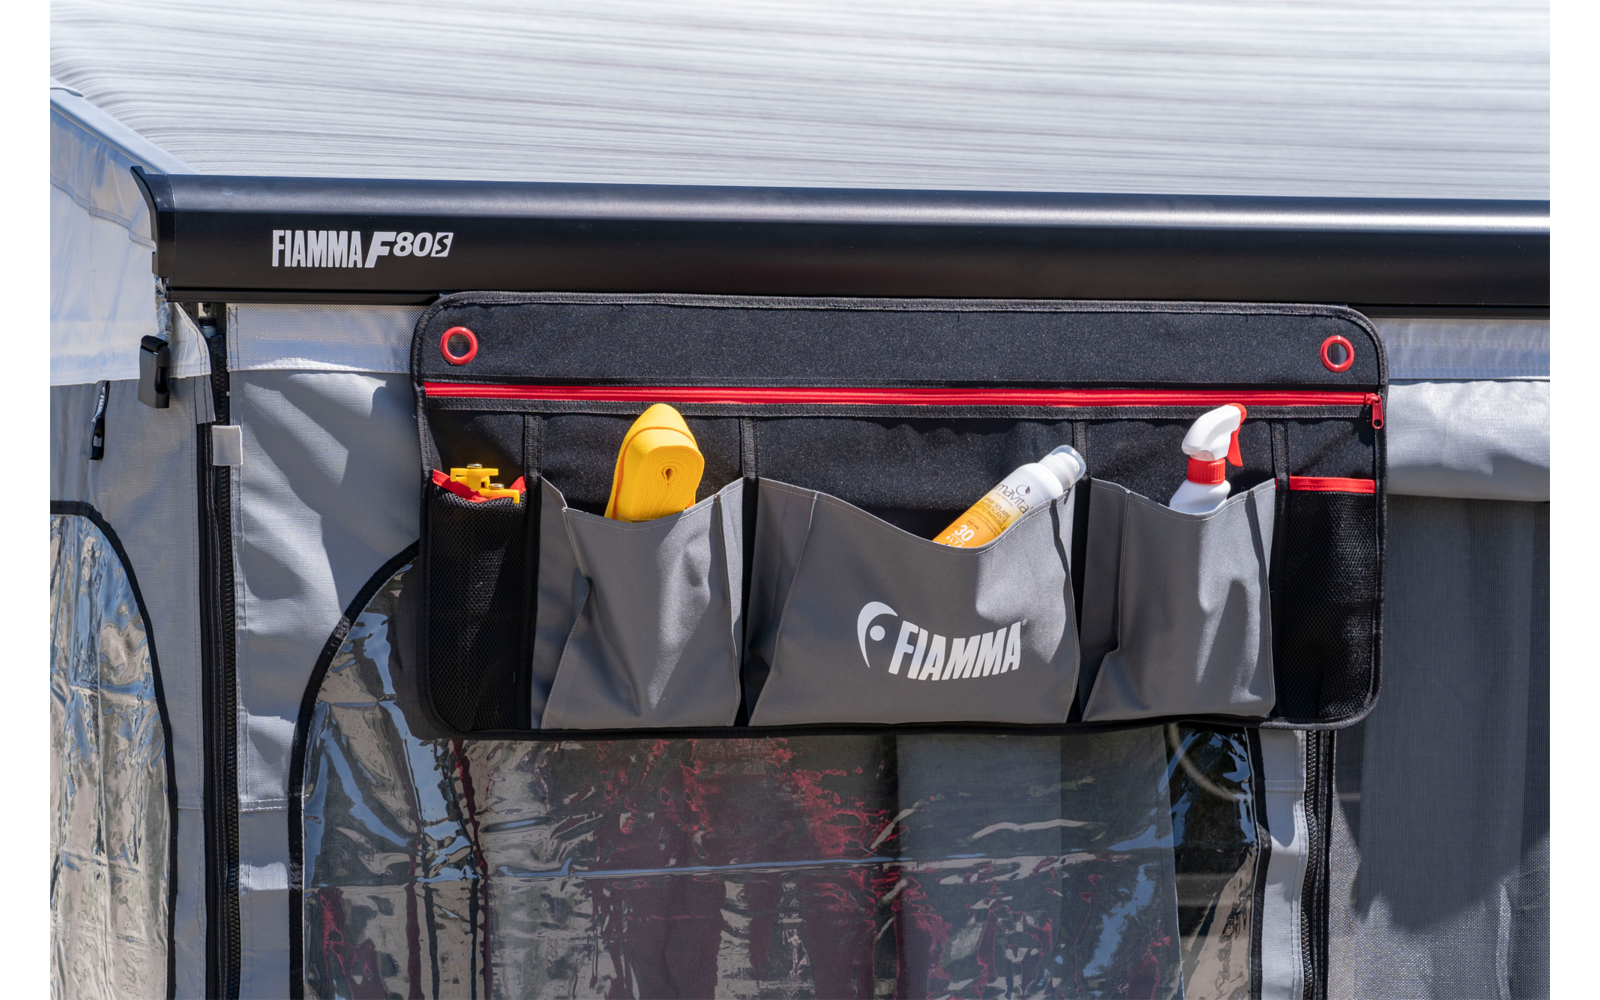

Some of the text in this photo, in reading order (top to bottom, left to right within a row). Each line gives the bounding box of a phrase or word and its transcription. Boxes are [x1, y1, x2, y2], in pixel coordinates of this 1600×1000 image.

[272, 230, 454, 268] FIAMMA F80S
[993, 502, 1011, 520] SOLARE
[994, 483, 1034, 514] mavita
[954, 524, 975, 542] 30
[888, 620, 1021, 681] FIAMMA
